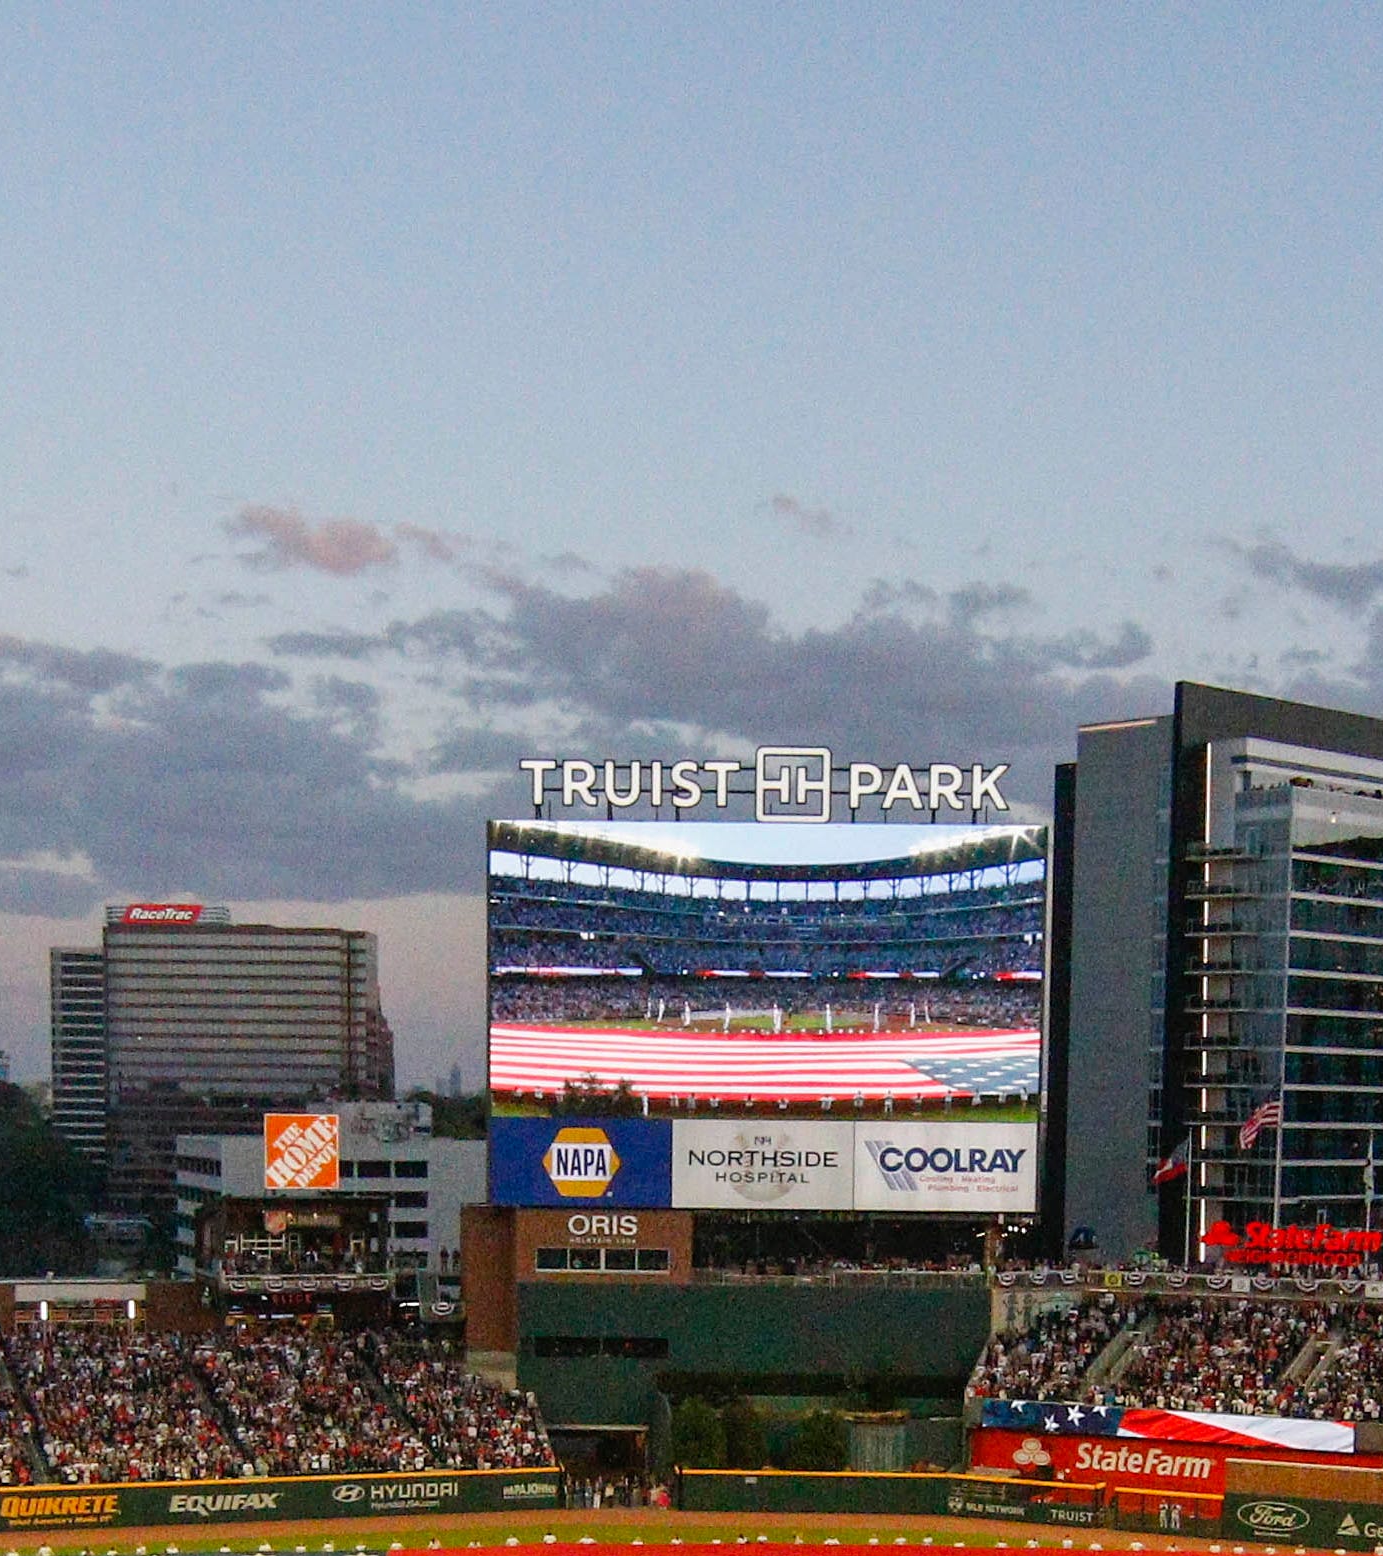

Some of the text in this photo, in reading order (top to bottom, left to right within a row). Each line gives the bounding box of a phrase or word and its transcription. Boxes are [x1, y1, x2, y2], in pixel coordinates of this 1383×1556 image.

[519, 759, 1011, 811] TRUIST PARK
[130, 908, 193, 920] RaceTrac
[273, 1122, 304, 1151] THE
[266, 1115, 338, 1187] HOME
[556, 1148, 608, 1177] NAPA
[688, 1150, 839, 1168] NORTHSIDE
[879, 1147, 1027, 1173] COOLRAY
[294, 1142, 338, 1188] DEPOT
[715, 1172, 810, 1184] HOSPITAL
[568, 1214, 638, 1236] ORIS
[370, 1482, 459, 1499] HYUNDAI
[0, 1495, 120, 1518] QUIKRETE
[169, 1493, 284, 1517] EQUIFAX
[985, 1505, 1025, 1516] NETWORK
[1050, 1509, 1094, 1522] TRUIST
[1249, 1504, 1297, 1528] Ford
